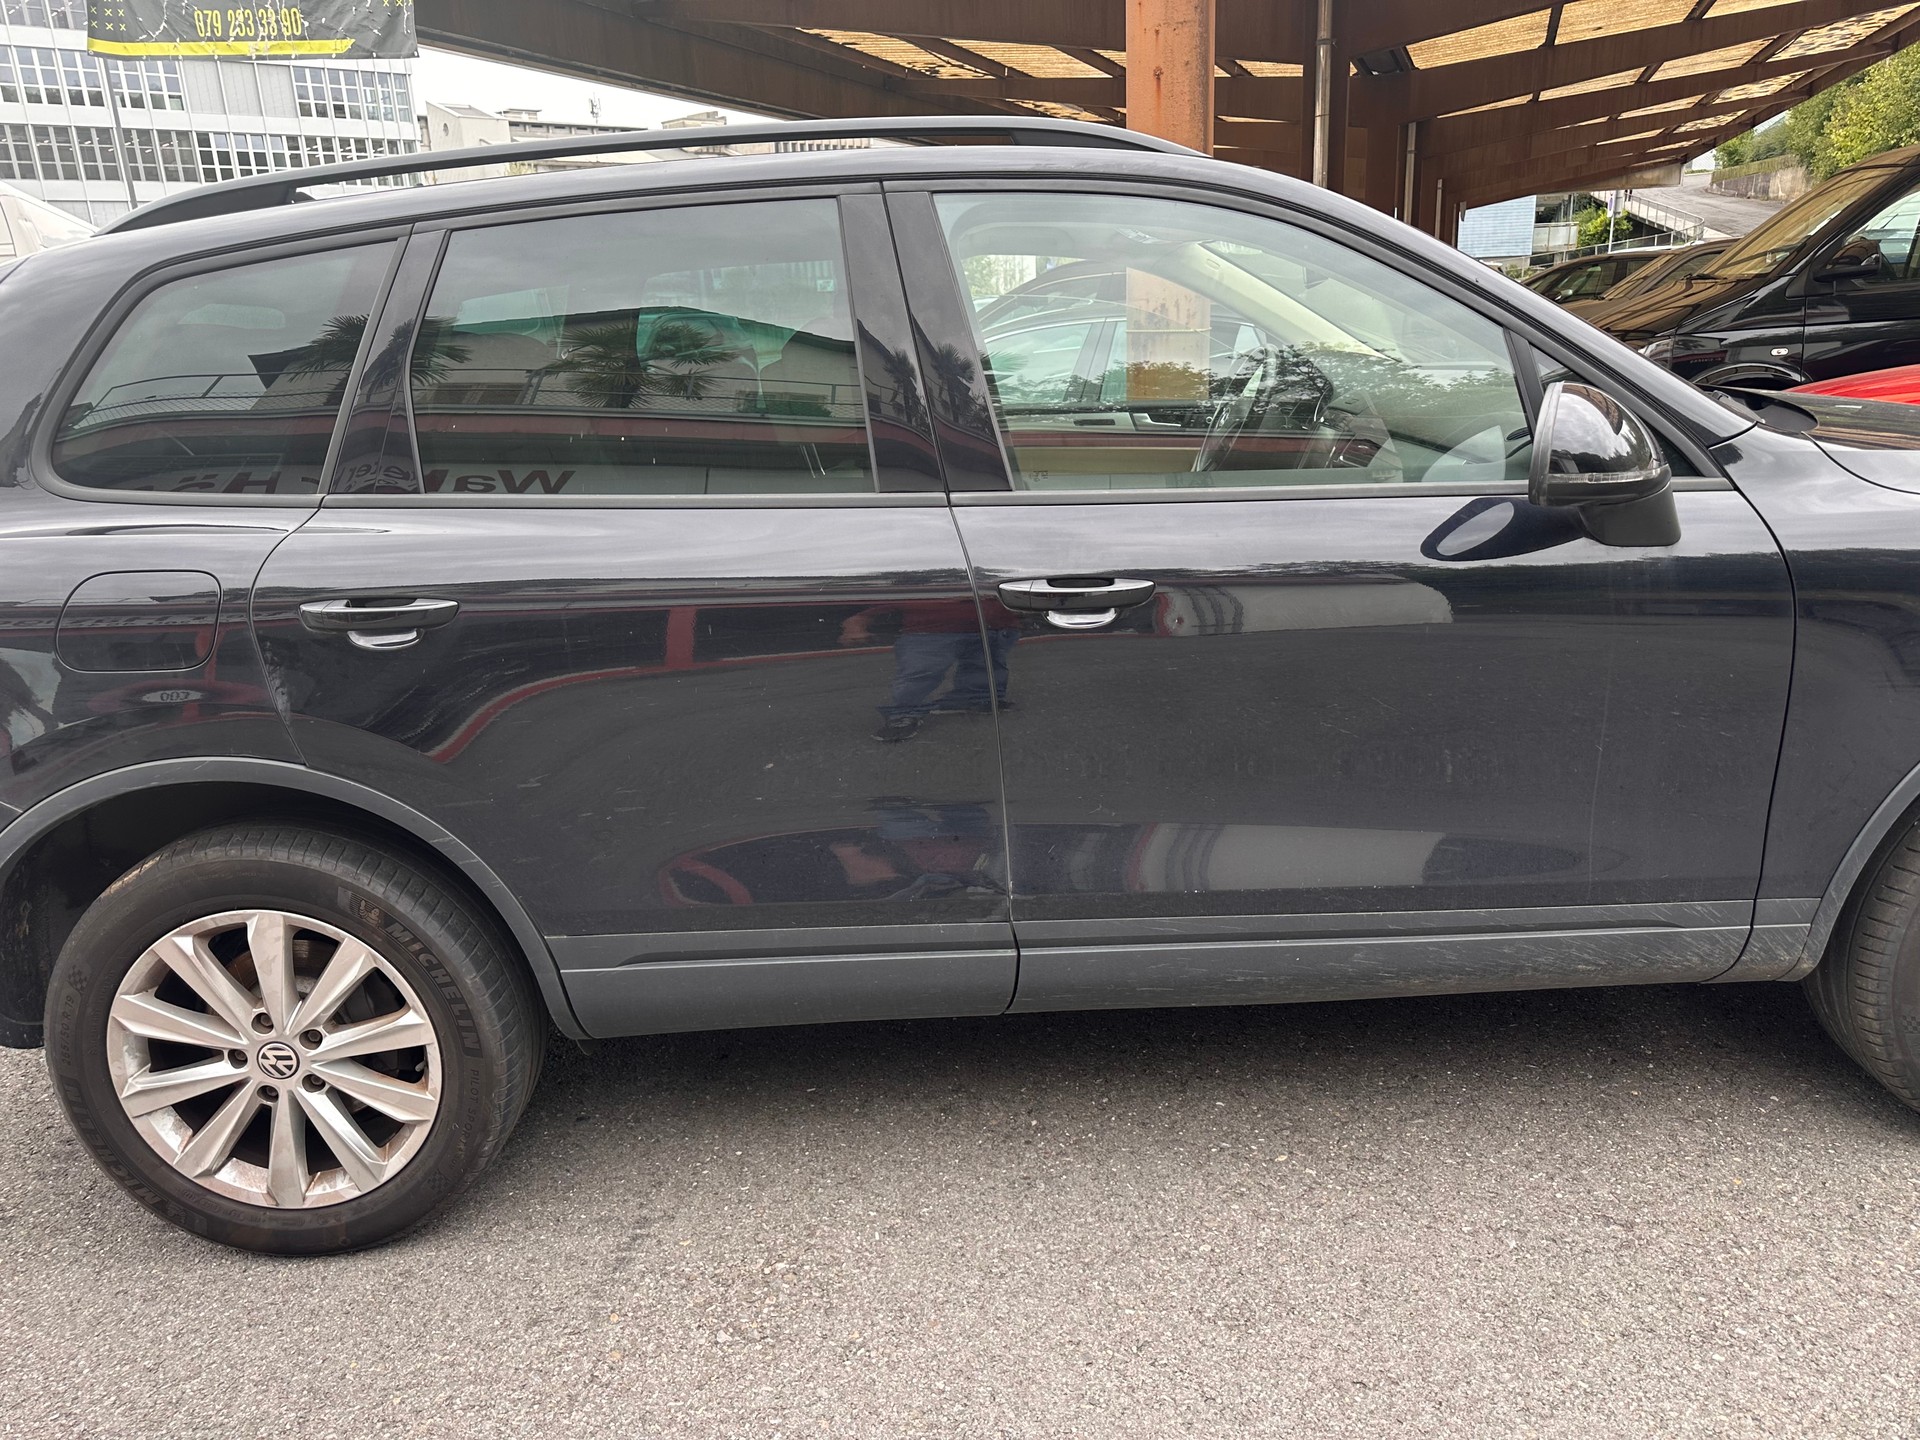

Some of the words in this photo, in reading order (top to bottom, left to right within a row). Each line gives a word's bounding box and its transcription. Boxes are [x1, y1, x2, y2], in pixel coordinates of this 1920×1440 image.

[194, 9, 222, 37] 079
[281, 7, 302, 36] 90
[385, 922, 481, 1050] MICHELIN
[470, 1068, 480, 1103] PILOT
[64, 1083, 163, 1204] MICHELIN
[459, 1108, 476, 1146] SPORT
